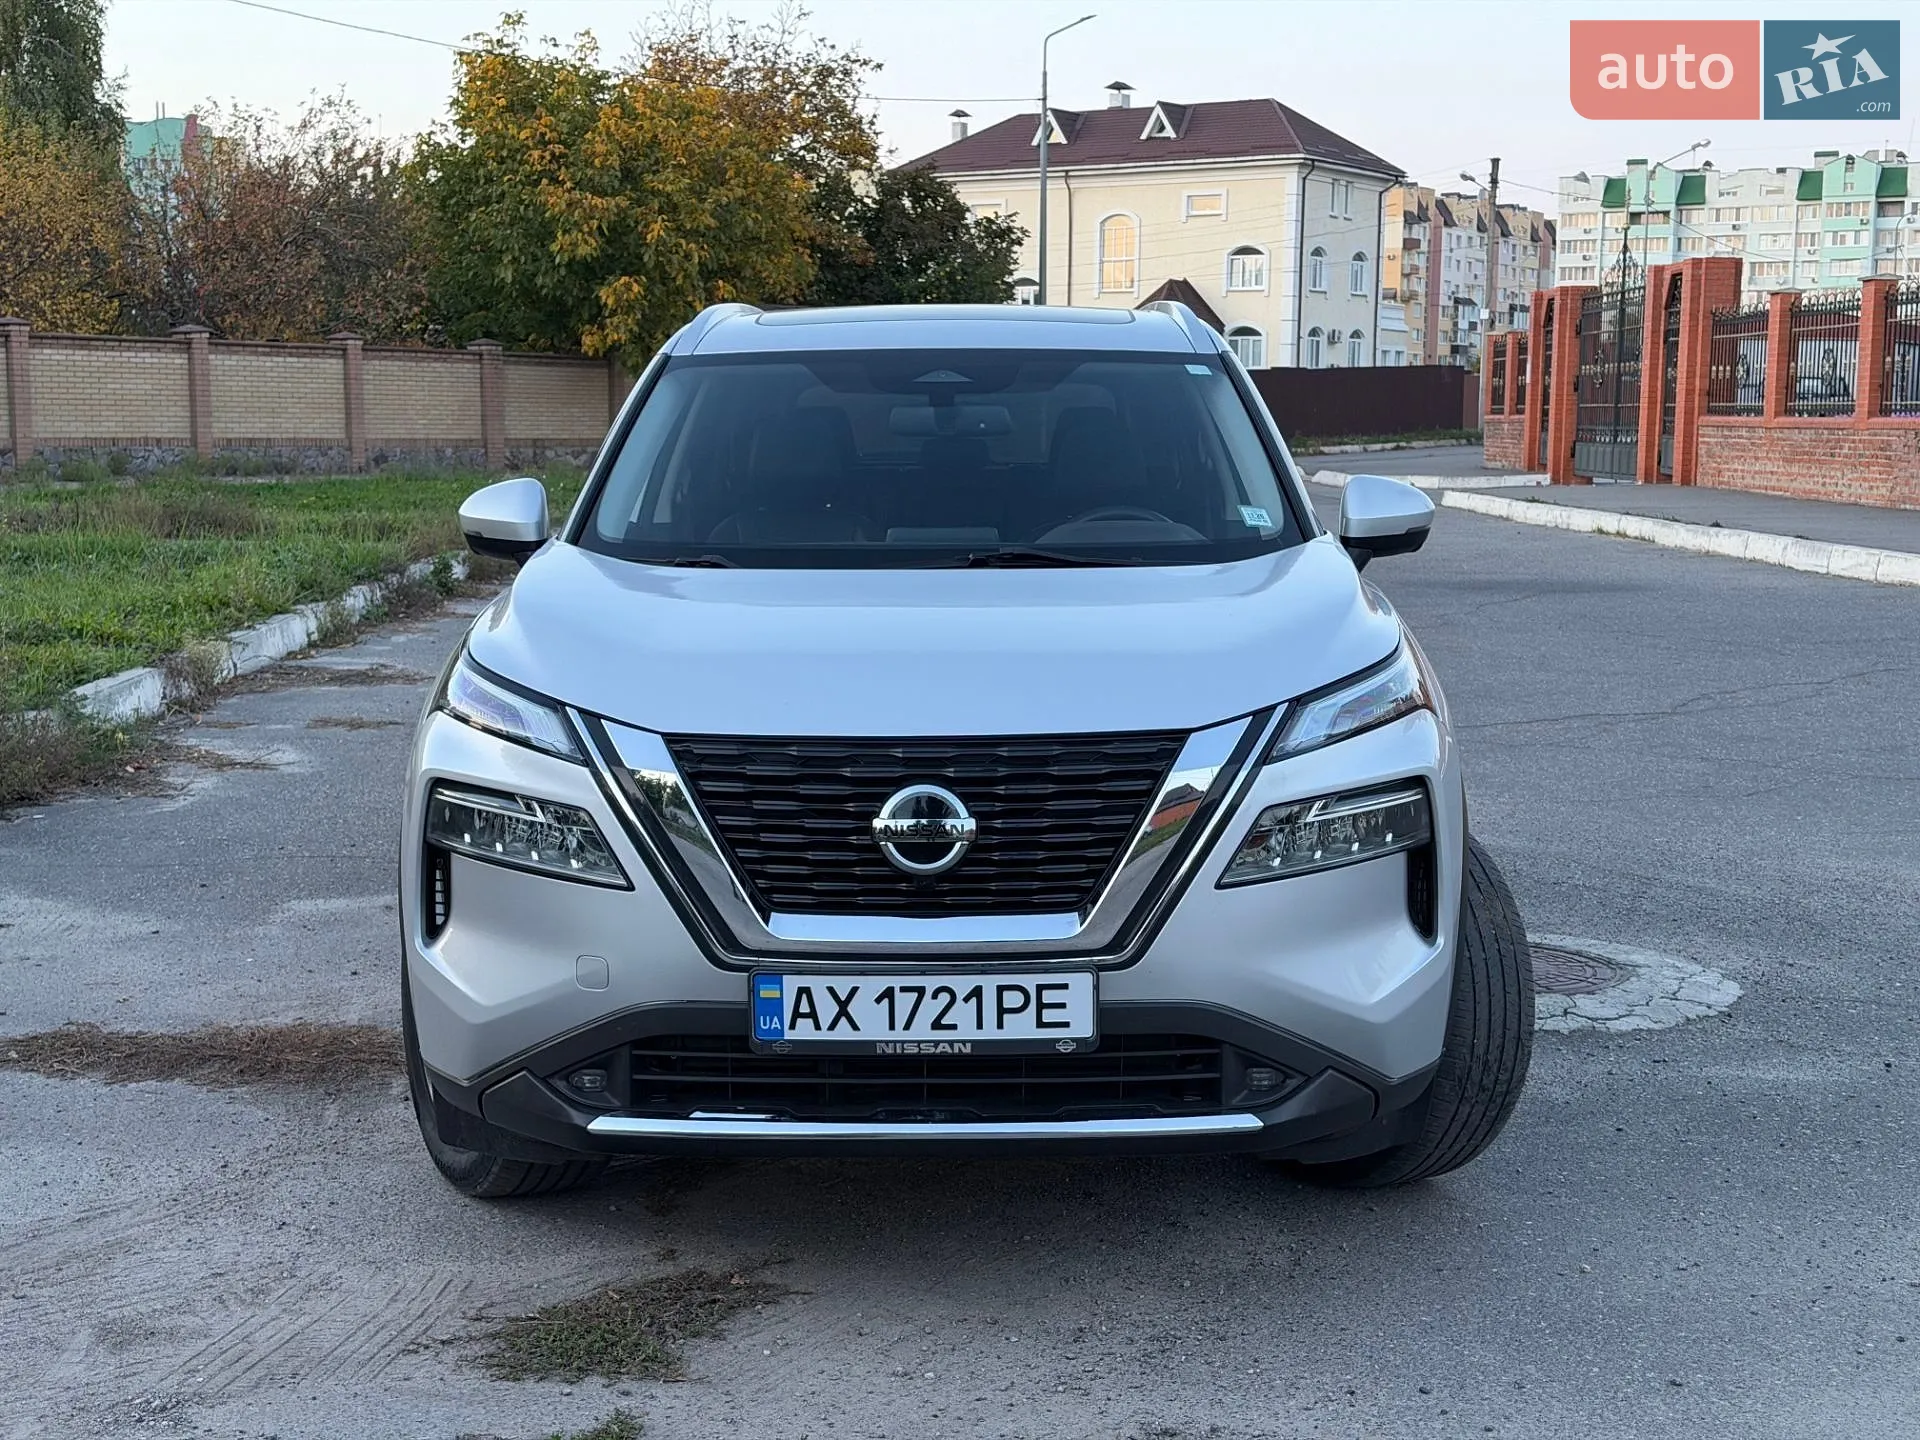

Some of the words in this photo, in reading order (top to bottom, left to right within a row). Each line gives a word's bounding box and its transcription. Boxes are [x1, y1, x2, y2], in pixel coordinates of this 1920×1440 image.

[883, 824, 965, 837] NISSAN
[788, 986, 861, 1031] AX
[759, 1015, 780, 1030] UA
[876, 1042, 972, 1054] NISSAN
